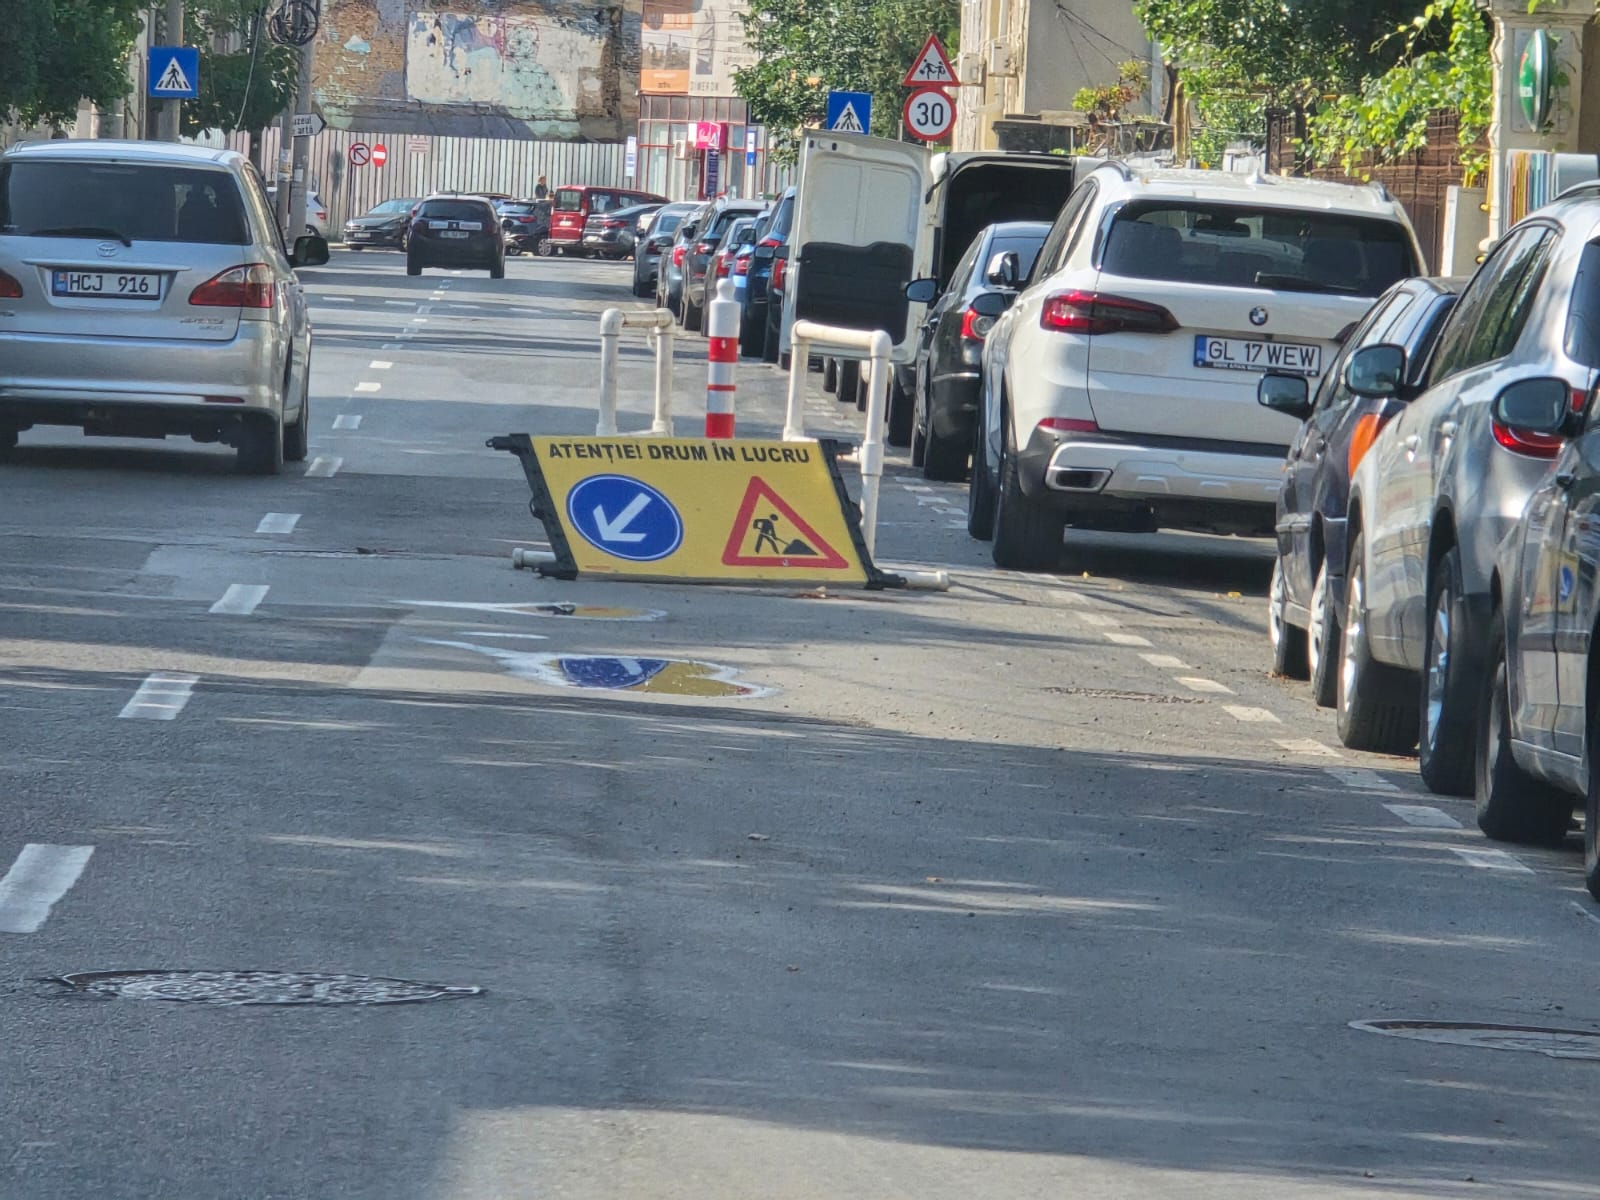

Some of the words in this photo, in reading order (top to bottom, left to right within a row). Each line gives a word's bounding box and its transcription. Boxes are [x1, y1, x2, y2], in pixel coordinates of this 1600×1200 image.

[916, 102, 944, 127] 30
[69, 274, 103, 291] HCJ
[118, 276, 149, 293] 916
[1209, 341, 1234, 361] GL
[1245, 343, 1263, 363] 17
[1267, 345, 1316, 367] WEW
[549, 443, 643, 464] ATENȚIE!
[647, 445, 708, 461] DRUM
[712, 442, 736, 461] ÎN
[741, 446, 810, 464] LUCRU
